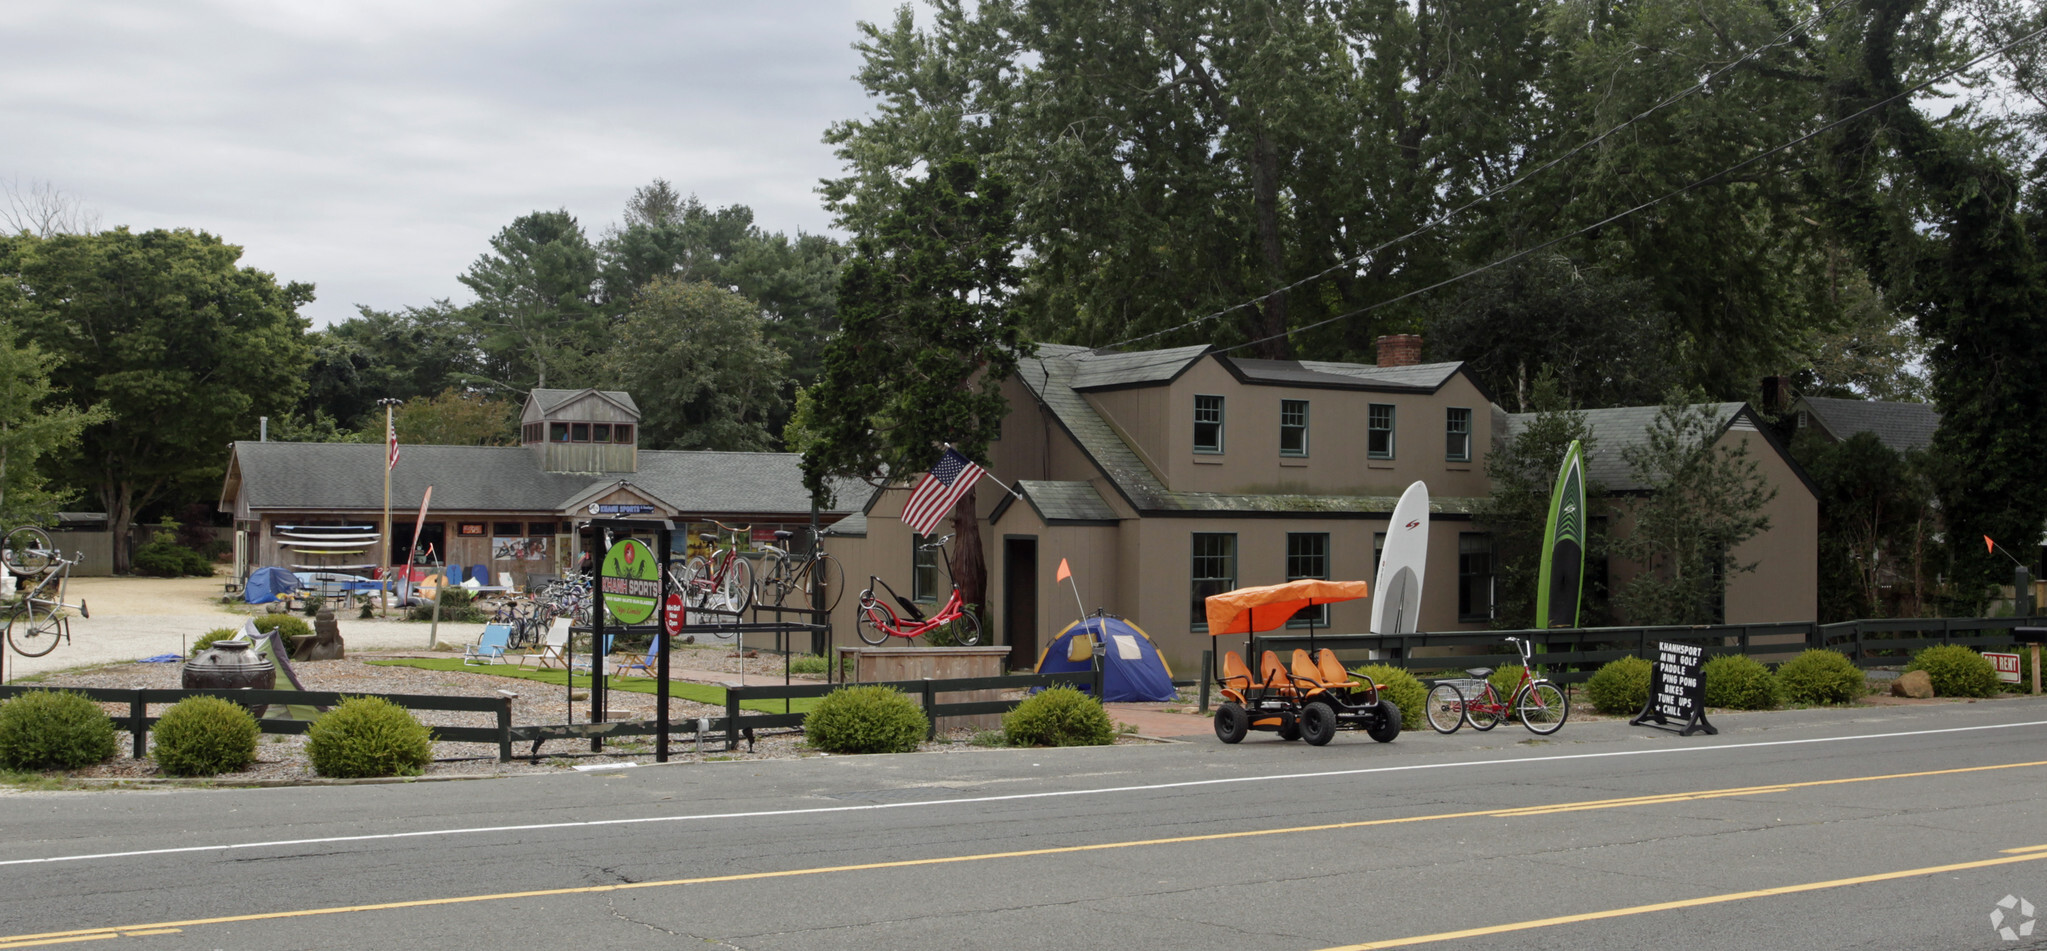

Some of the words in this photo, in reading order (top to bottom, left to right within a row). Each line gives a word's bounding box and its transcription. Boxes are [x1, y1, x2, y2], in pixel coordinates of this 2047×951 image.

[619, 505, 640, 513] SPORTS
[602, 577, 628, 594] KHANH
[629, 580, 658, 597] SPORTS
[1659, 641, 1702, 657] KHANHSPORT
[1680, 655, 1698, 667] GOLF
[1999, 656, 2017, 671] RENT
[1660, 662, 1686, 675] PADDLE
[1662, 673, 1678, 684] PING
[1679, 676, 1697, 688] PONG
[1664, 684, 1684, 696] BIKES
[1658, 693, 1675, 705] TUNE
[1678, 696, 1692, 708] UPS
[1662, 704, 1681, 717] CHILL
